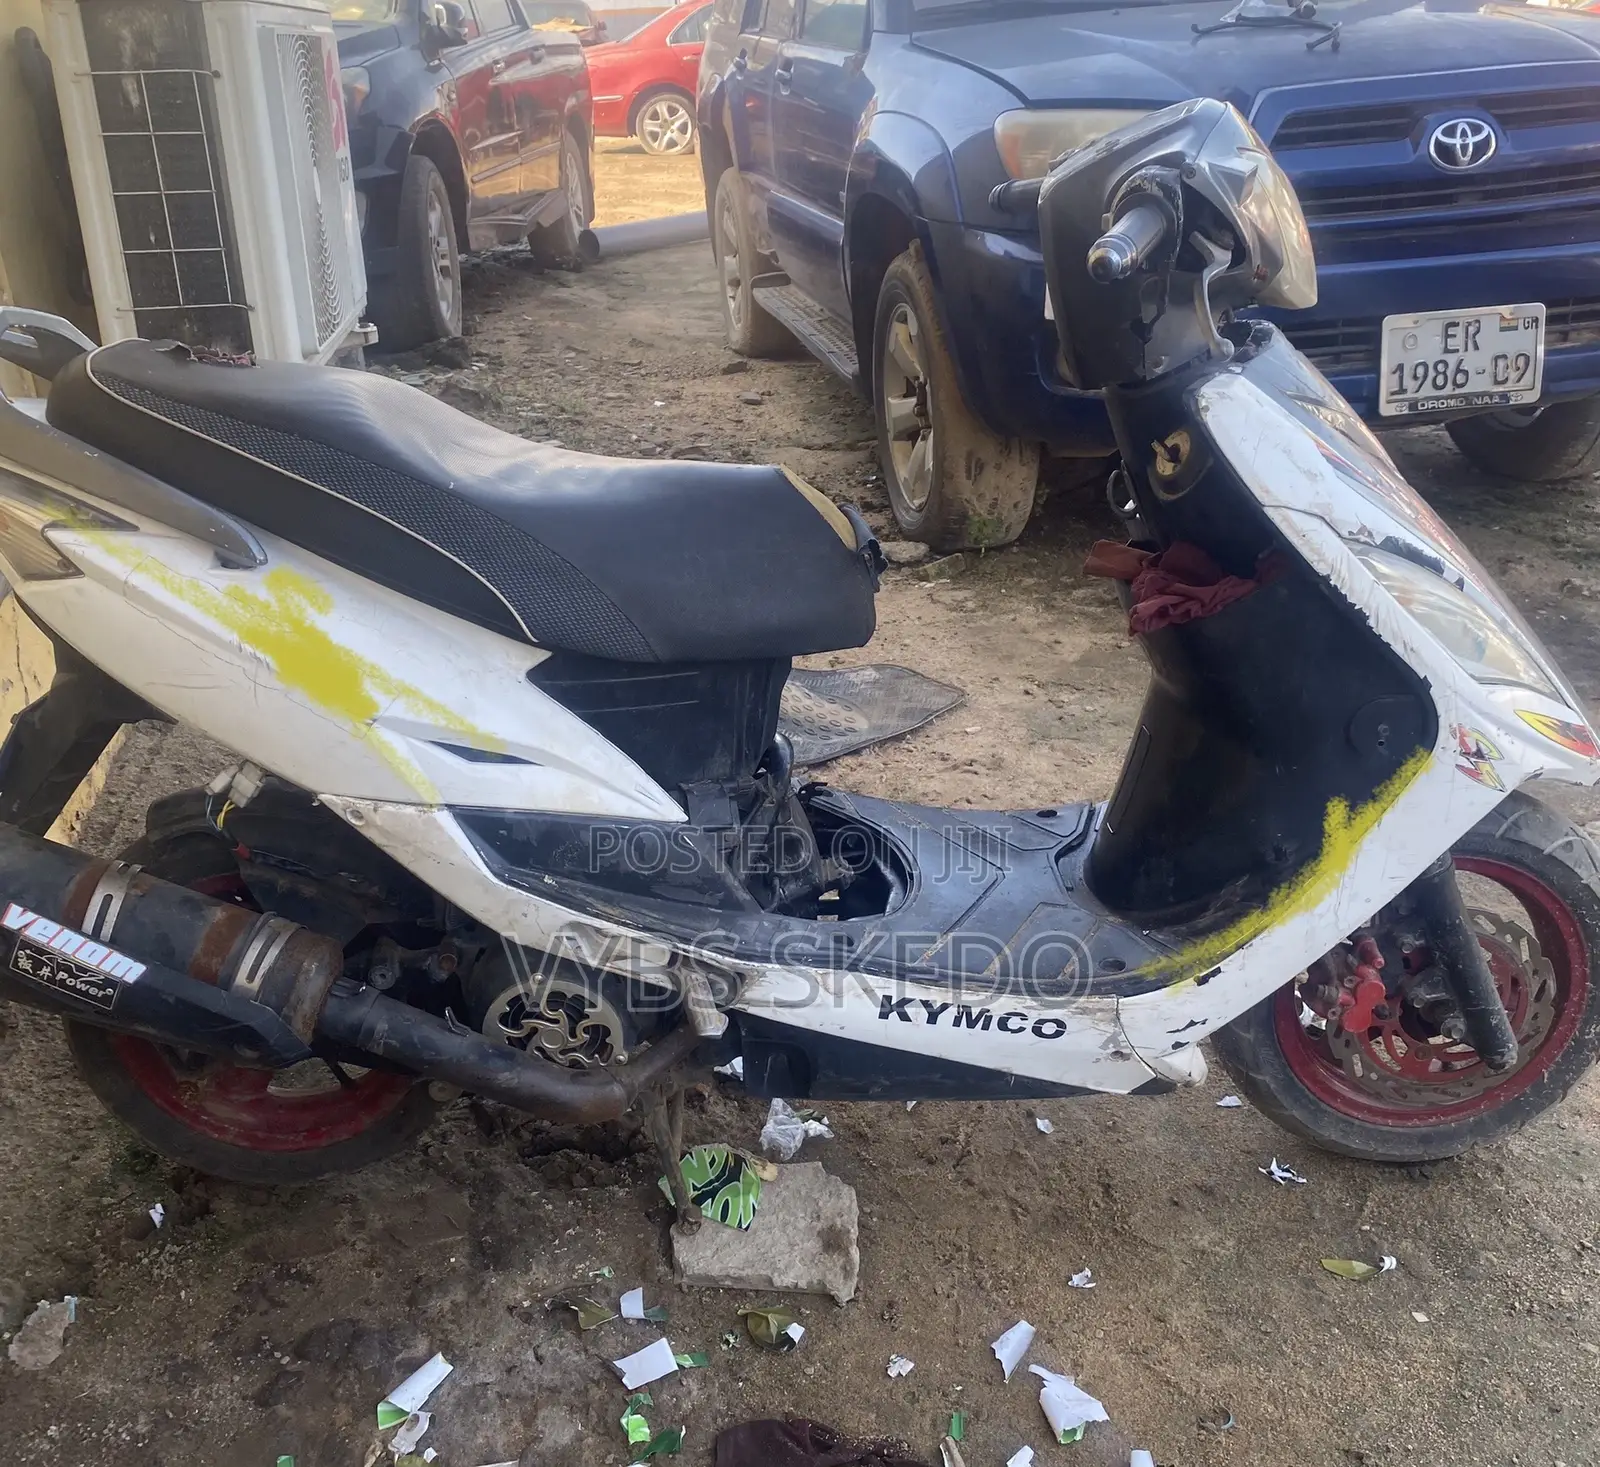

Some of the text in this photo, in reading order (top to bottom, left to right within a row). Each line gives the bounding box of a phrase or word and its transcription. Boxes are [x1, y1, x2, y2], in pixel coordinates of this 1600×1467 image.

[1443, 319, 1481, 354] ER
[55, 970, 107, 999] Power
[878, 994, 1067, 1040] KYMCO
